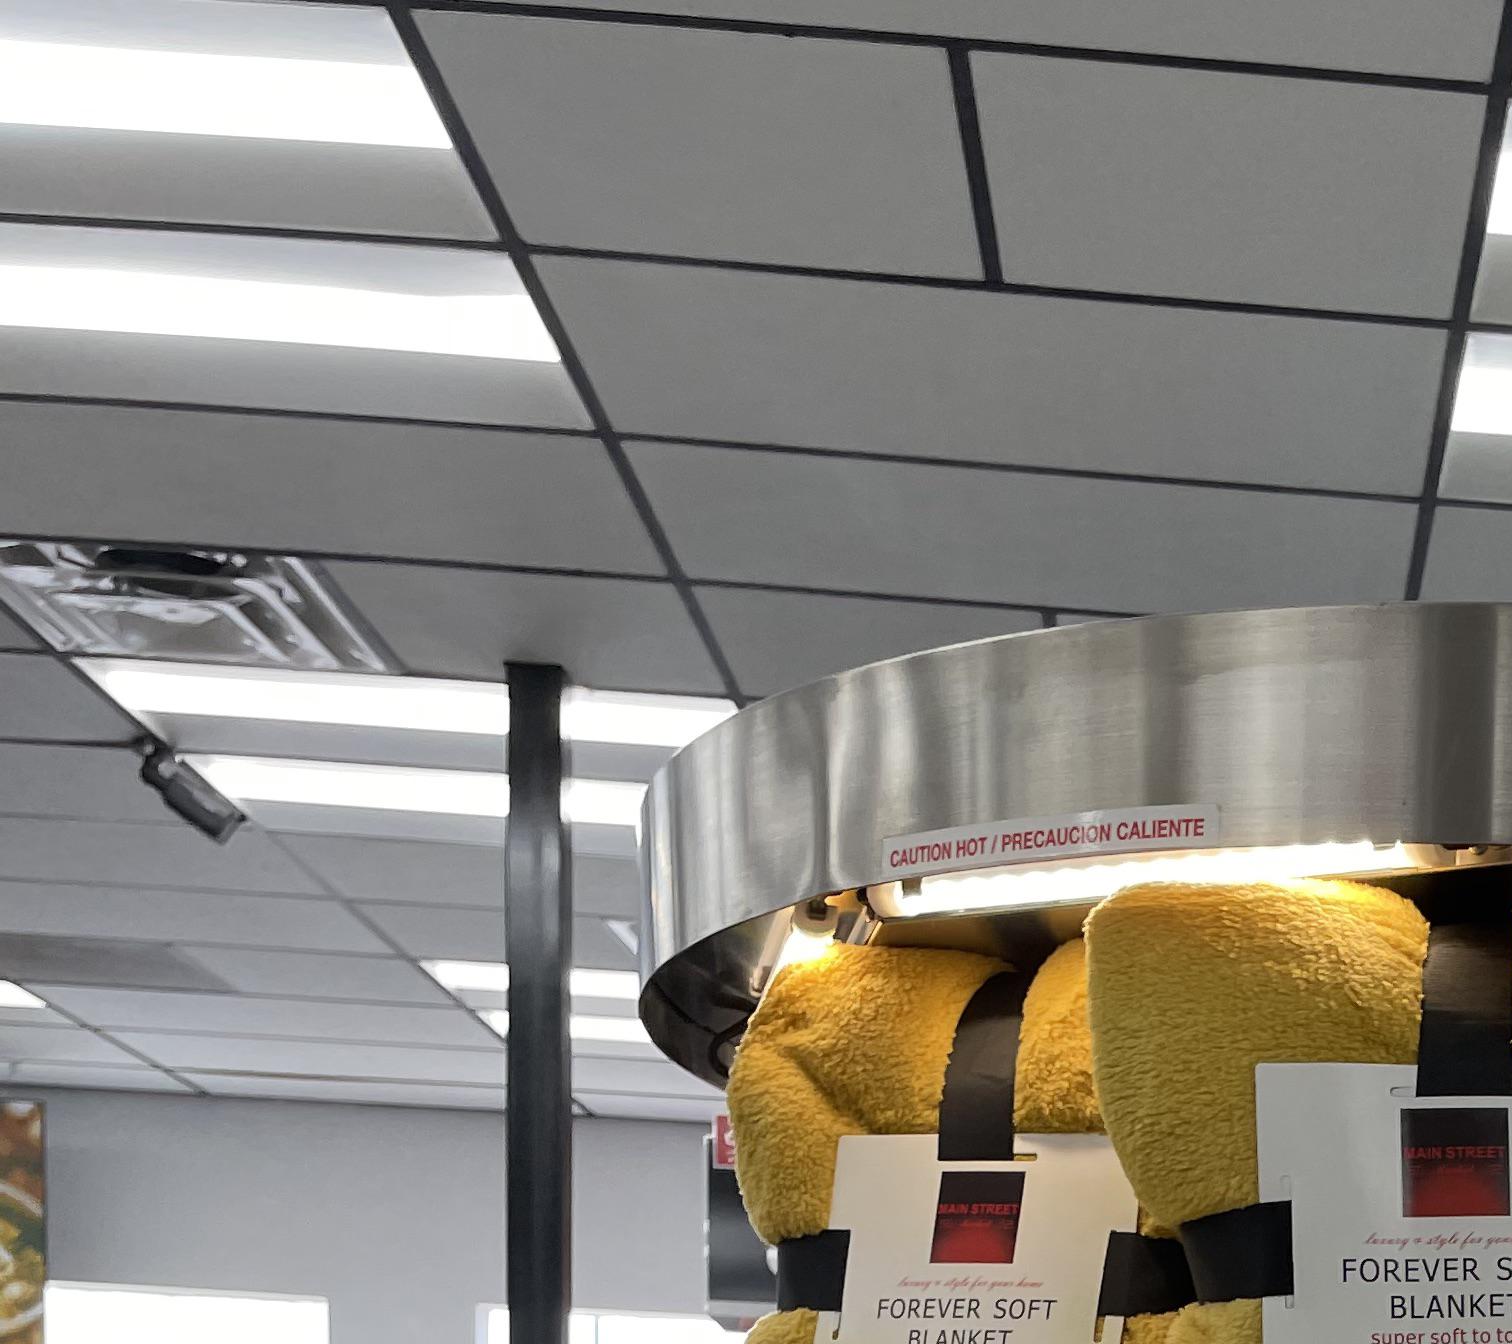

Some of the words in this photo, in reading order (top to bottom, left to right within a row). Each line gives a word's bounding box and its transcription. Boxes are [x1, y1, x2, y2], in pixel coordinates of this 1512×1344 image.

[891, 841, 951, 868] CAUTION
[956, 836, 986, 856] HOT
[992, 836, 997, 854] /
[1002, 824, 1111, 852] PRECAUCION
[1117, 818, 1205, 840] CALIENTE
[1404, 1146, 1442, 1159] MAIN
[1446, 1146, 1505, 1159] STREET
[938, 1203, 969, 1216] MAIN
[972, 1203, 1018, 1216] STREET
[1342, 1258, 1480, 1282] FOREVER
[877, 1299, 980, 1321] FOREVER
[993, 1300, 1057, 1321] SOFT
[1431, 1329, 1468, 1344] soft
[1472, 1330, 1491, 1344] to
